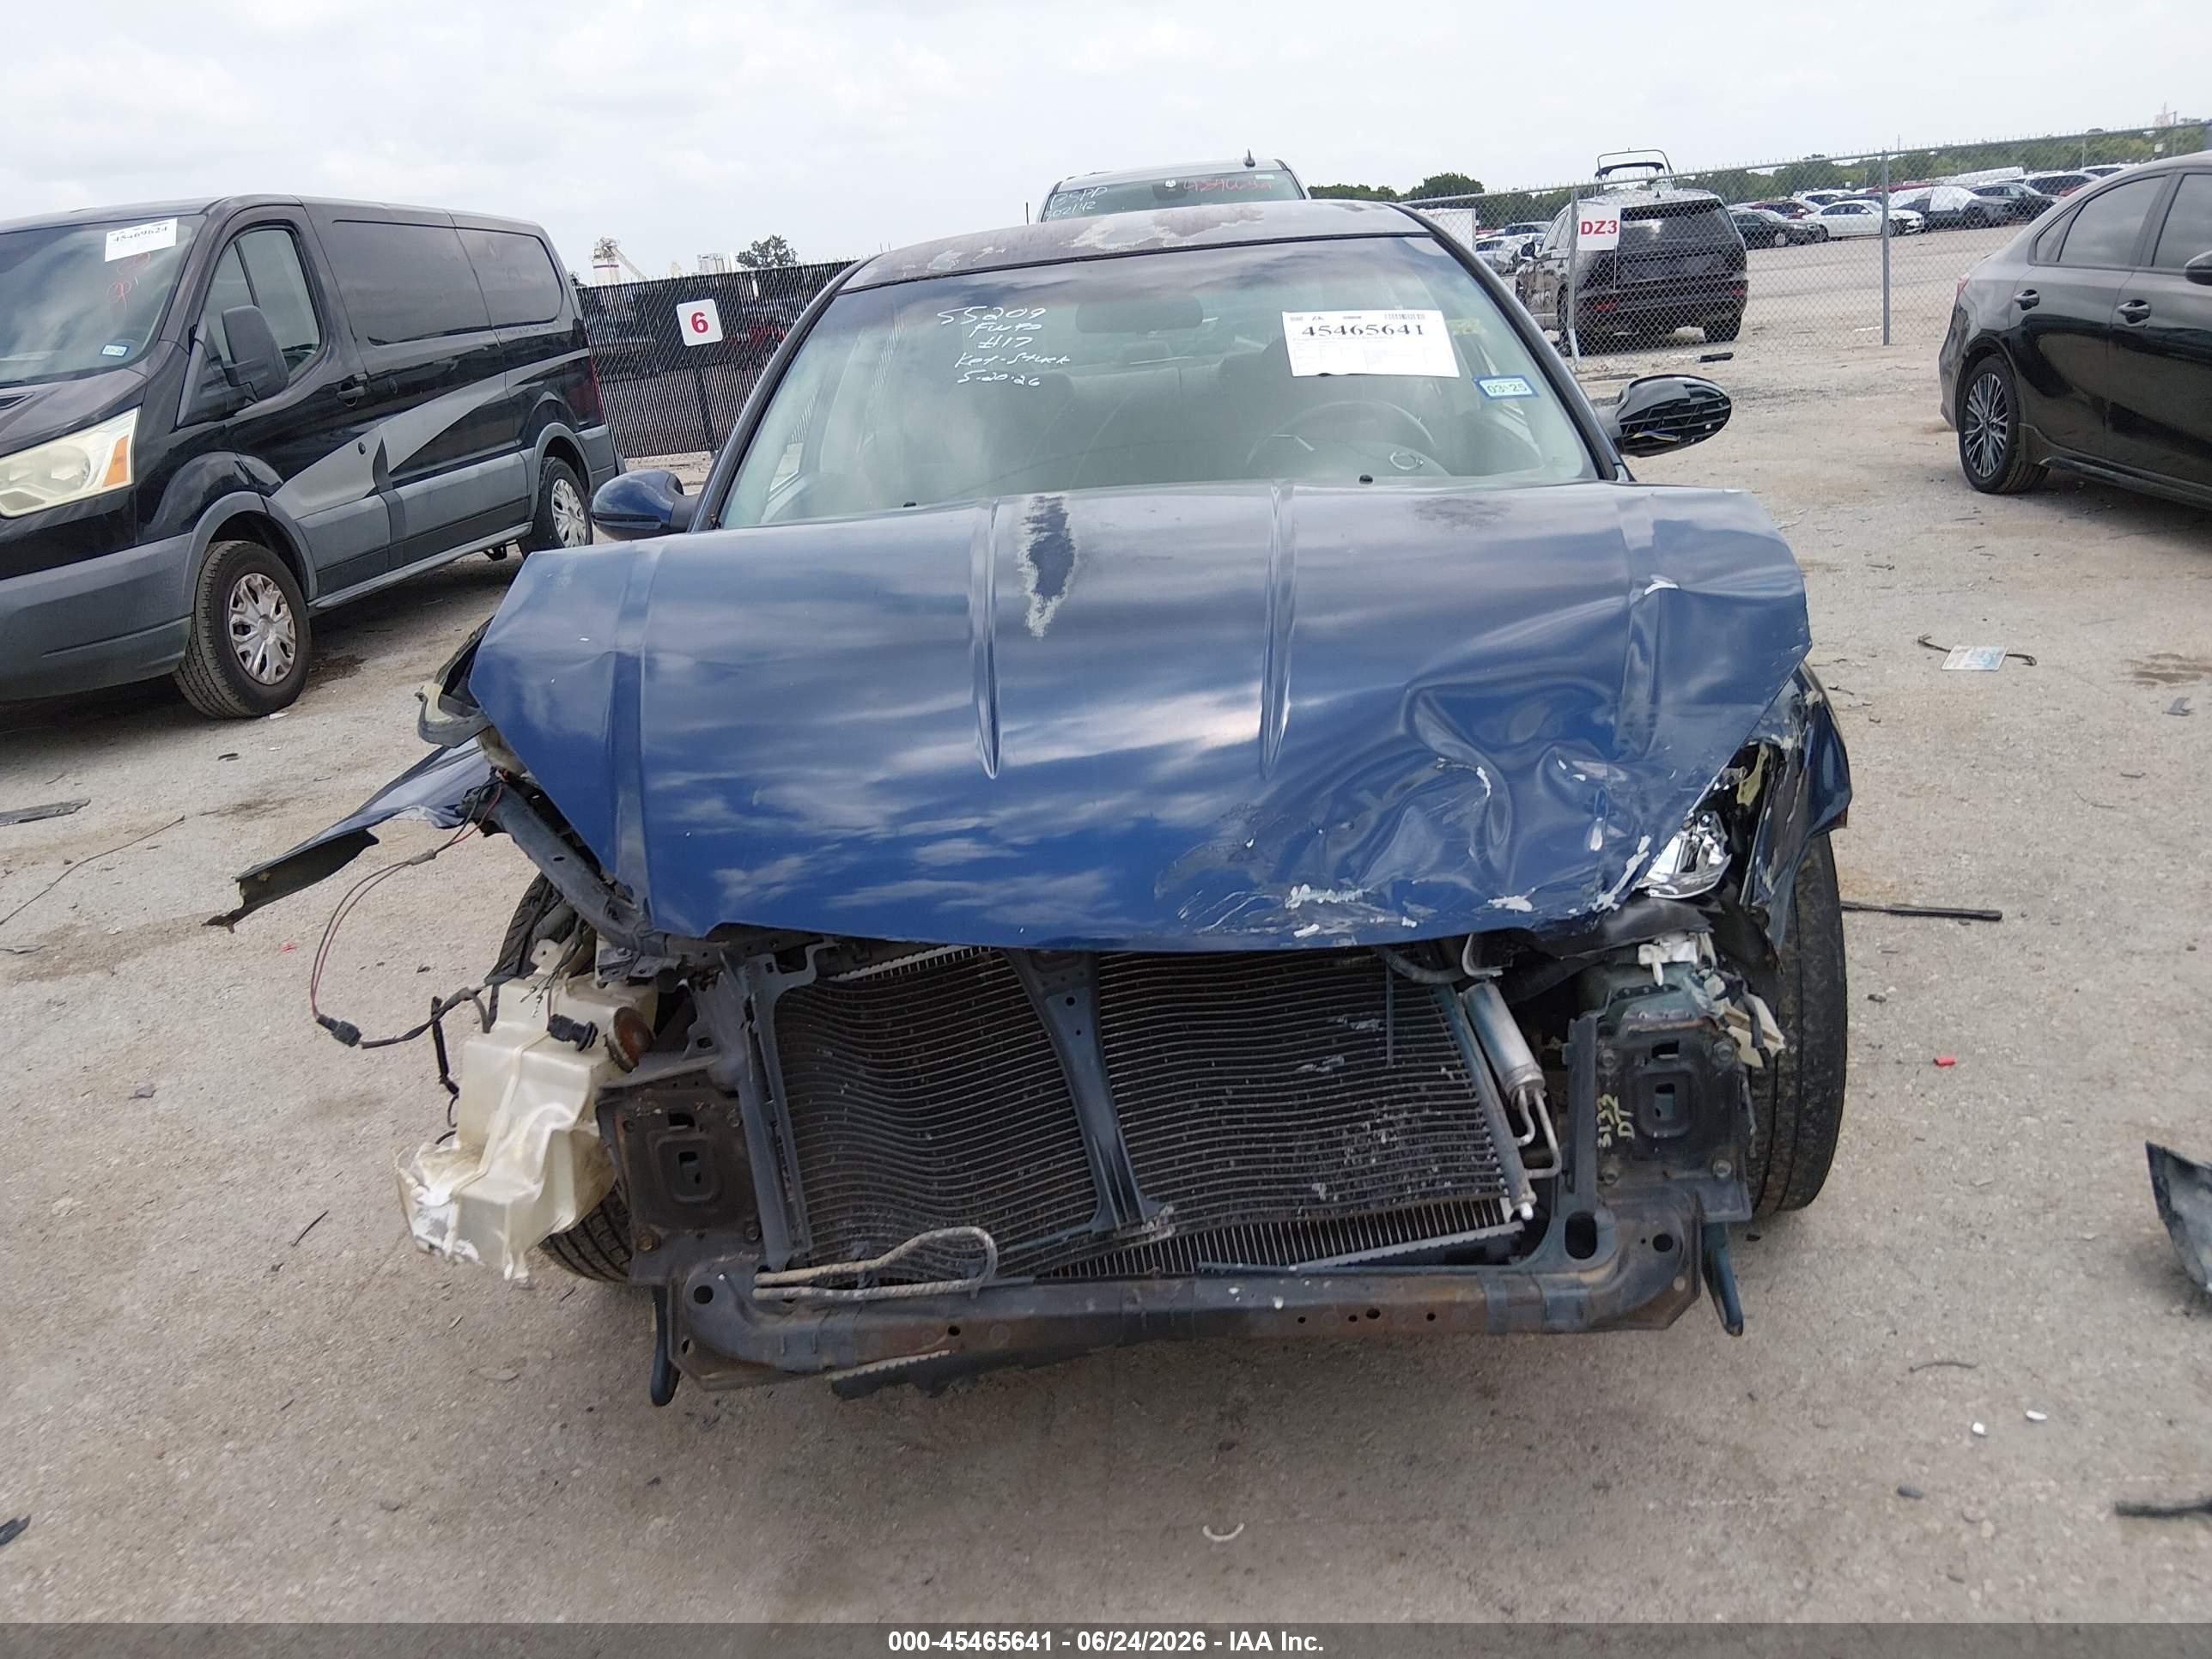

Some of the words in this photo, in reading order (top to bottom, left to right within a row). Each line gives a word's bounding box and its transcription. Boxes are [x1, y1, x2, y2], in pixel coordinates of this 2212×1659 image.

[1580, 220, 1617, 235] DZ3
[691, 312, 709, 333] 6
[1302, 325, 1424, 337] 45465641
